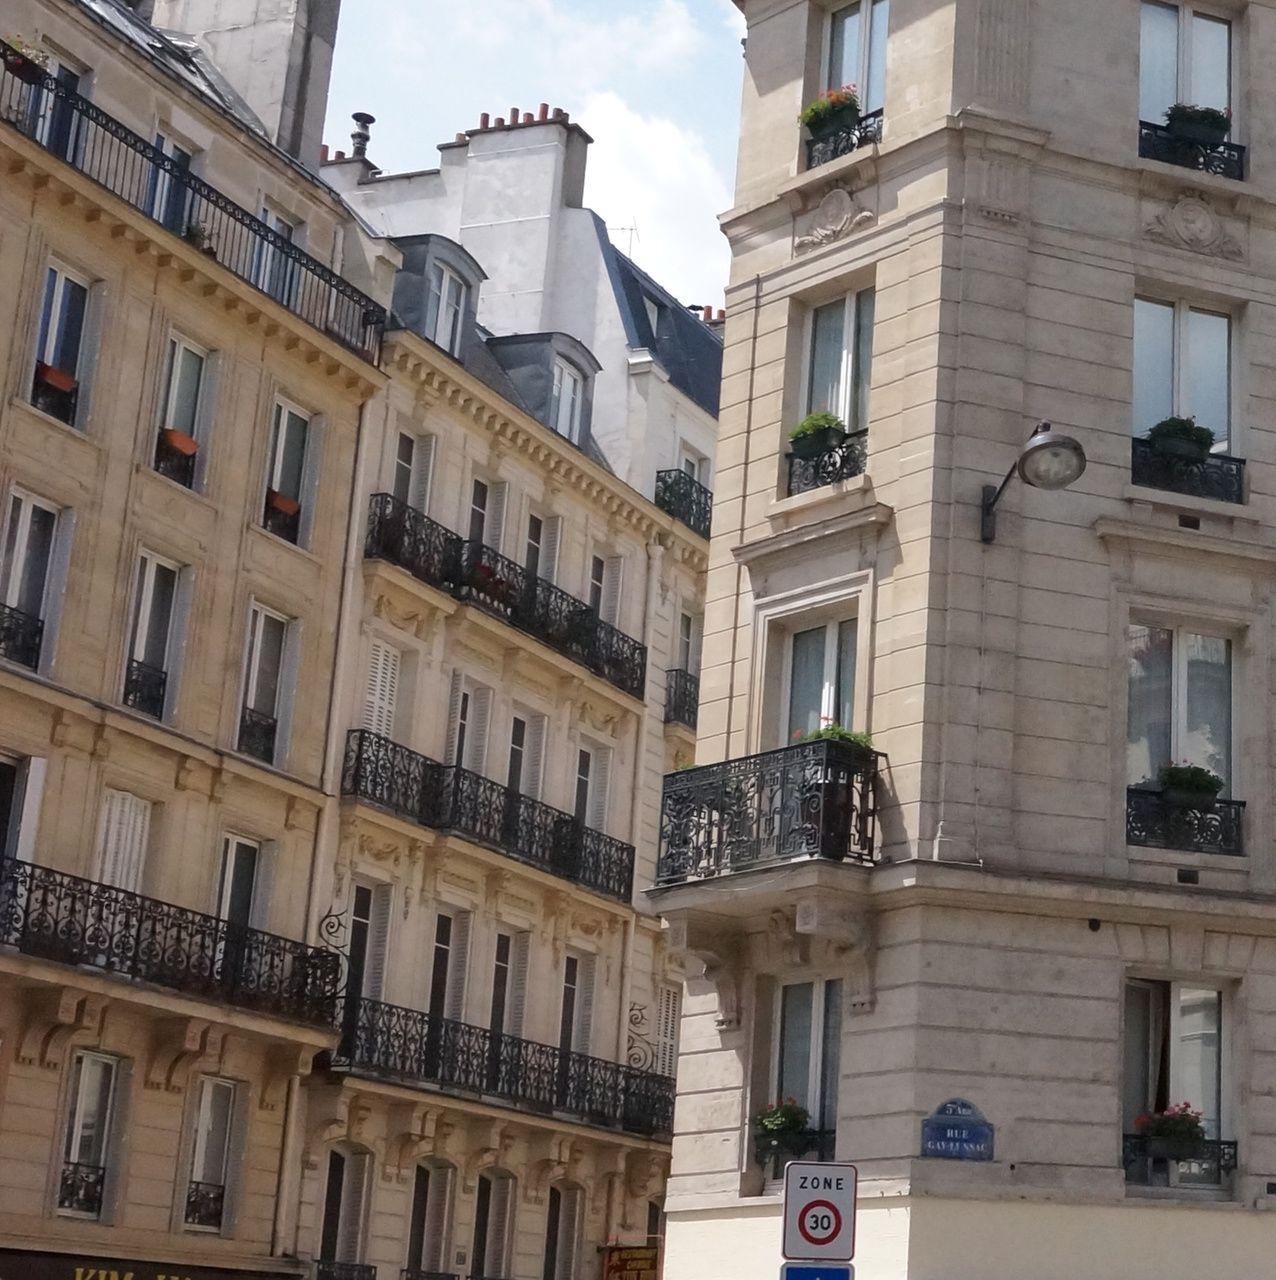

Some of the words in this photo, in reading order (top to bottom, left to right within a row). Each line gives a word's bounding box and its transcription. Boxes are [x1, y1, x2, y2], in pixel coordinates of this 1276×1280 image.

[946, 1128, 969, 1139] RUE
[799, 1176, 844, 1190] ZONE
[809, 1214, 831, 1230] 30
